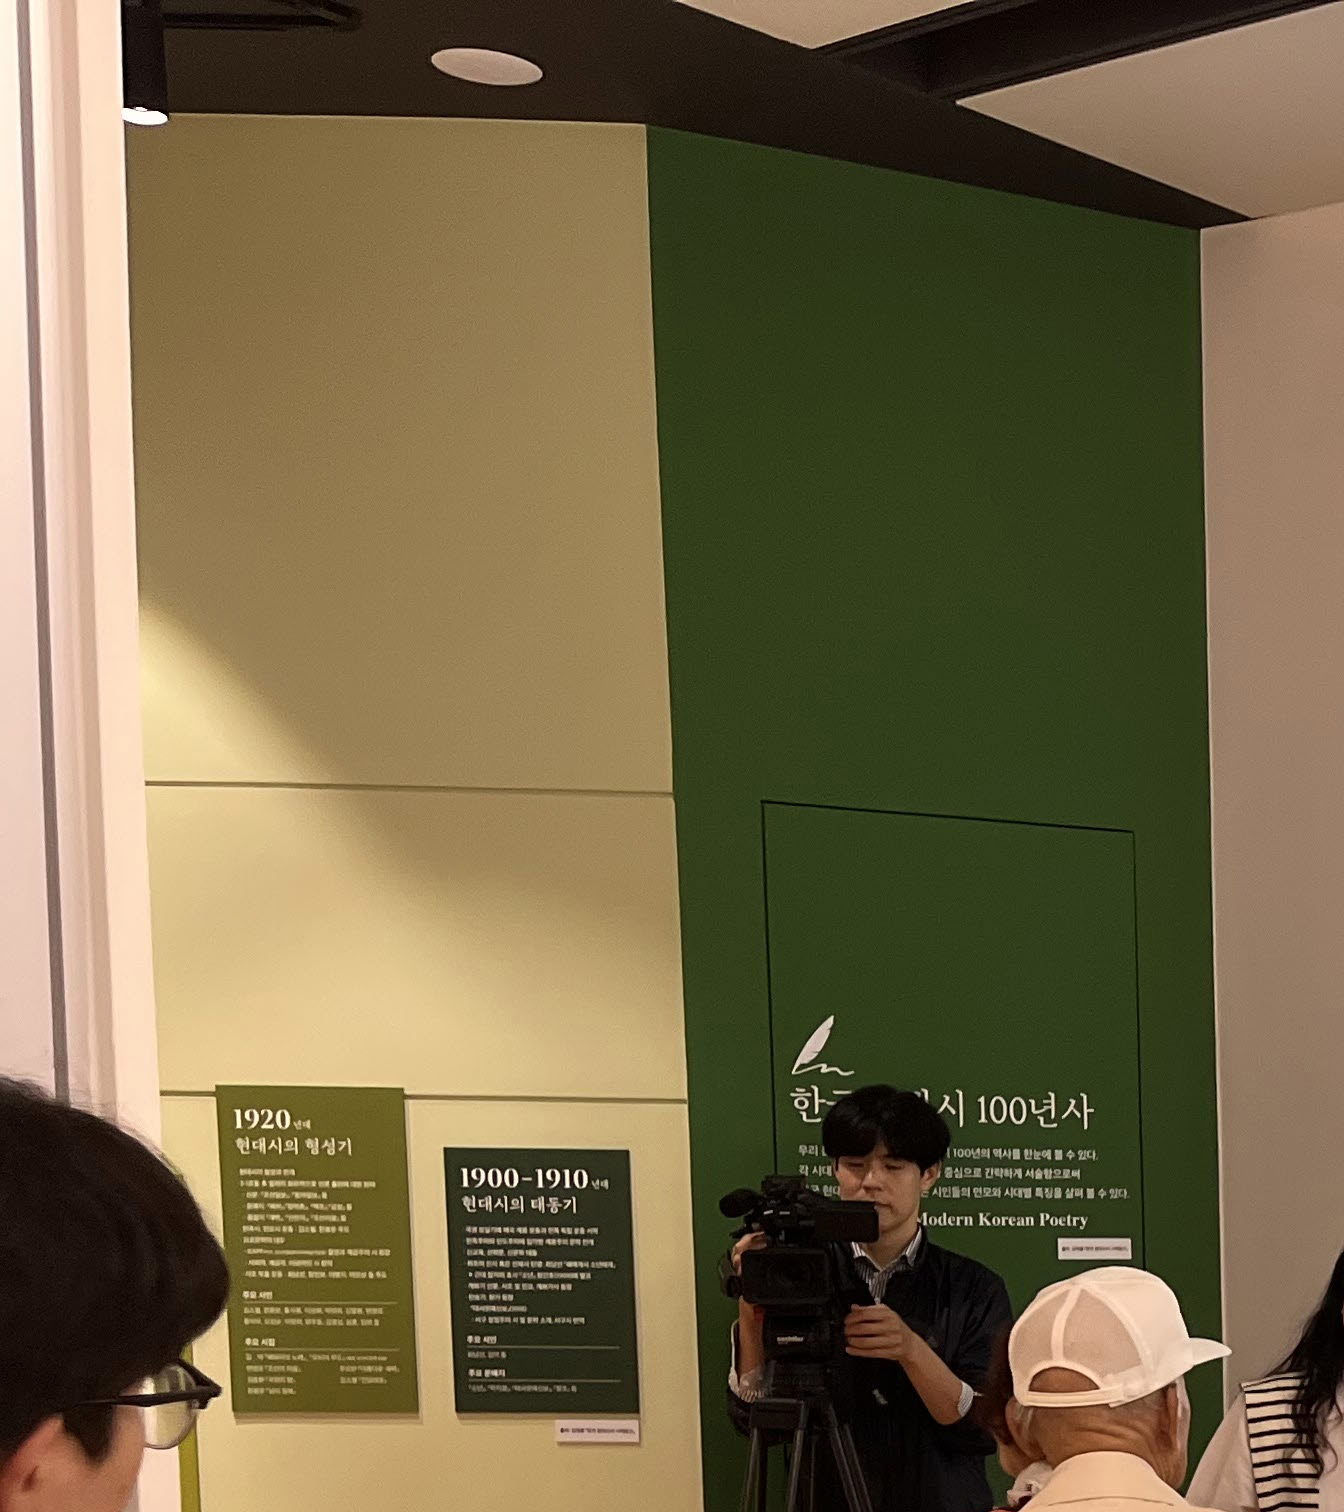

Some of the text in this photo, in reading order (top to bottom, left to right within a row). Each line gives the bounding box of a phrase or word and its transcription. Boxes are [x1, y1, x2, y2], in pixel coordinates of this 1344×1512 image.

[977, 1092, 1095, 1130] 100년사
[236, 1136, 352, 1156] 현대시의 형성기
[799, 1145, 818, 1157] 우리
[953, 1148, 990, 1159] 100년의
[992, 1148, 1020, 1160] 역사를
[1023, 1148, 1052, 1160] 한눈에
[1066, 1149, 1075, 1160] 수
[932, 1186, 971, 1198] 시인들의
[461, 1195, 524, 1213] 현대시의
[979, 1212, 1034, 1226] Korean
[1040, 1212, 1088, 1230] Poetry
